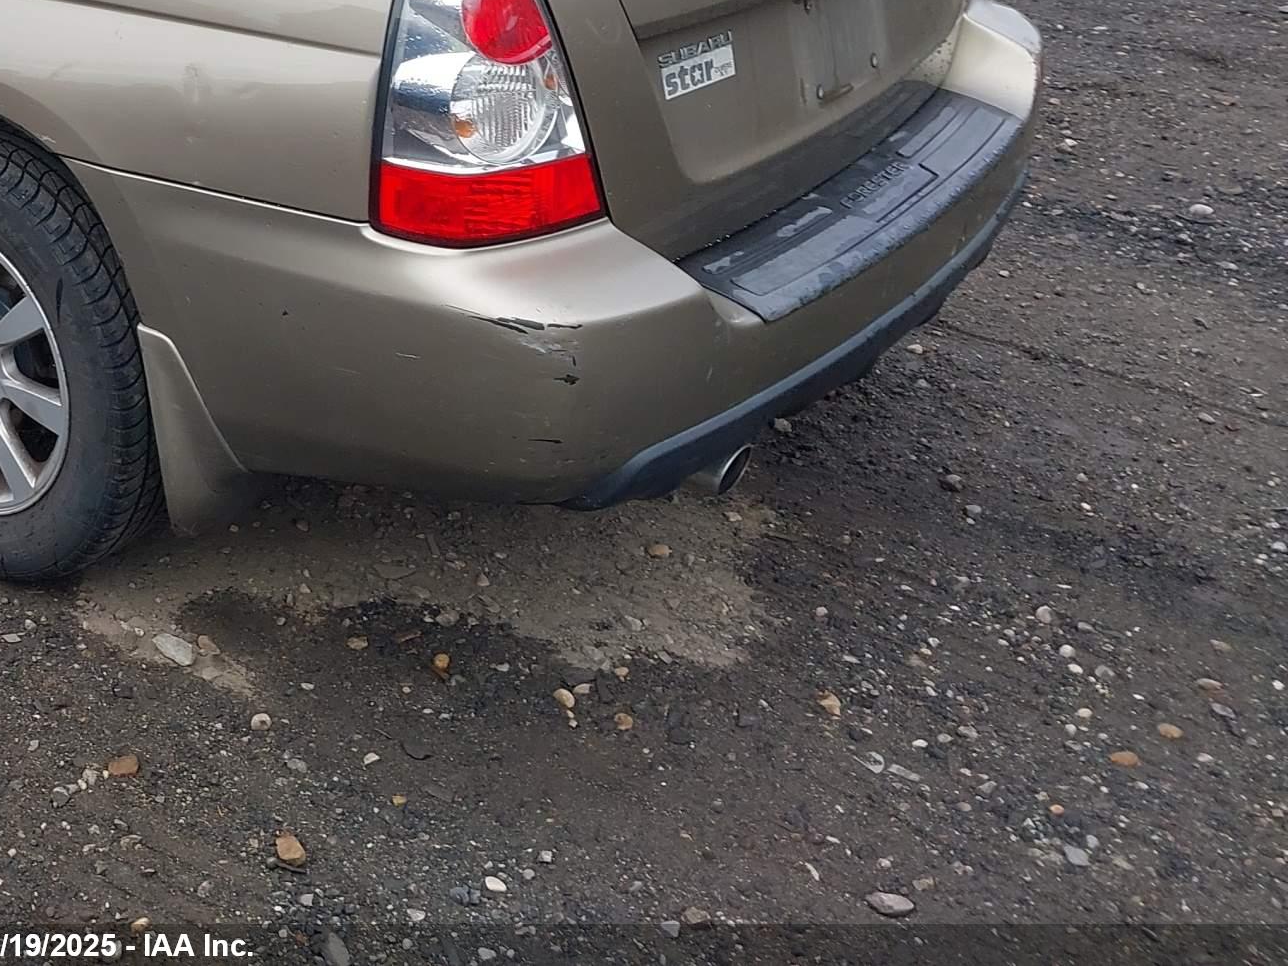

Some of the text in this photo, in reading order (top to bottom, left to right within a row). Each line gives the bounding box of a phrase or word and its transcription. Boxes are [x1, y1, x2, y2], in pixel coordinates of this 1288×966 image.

[657, 30, 733, 69] SUBARU
[665, 58, 714, 97] star
[839, 160, 909, 210] FORESTER
